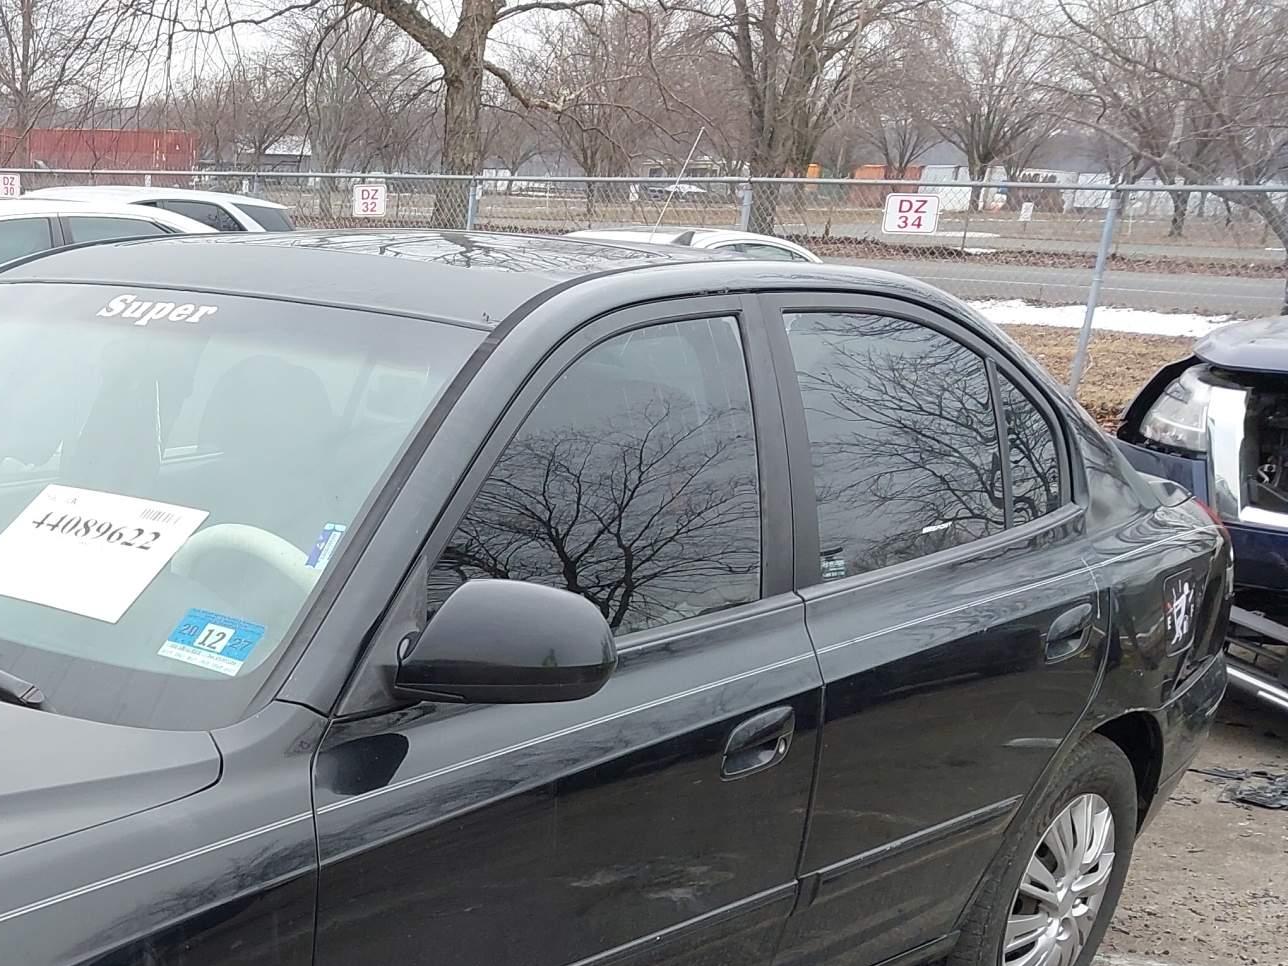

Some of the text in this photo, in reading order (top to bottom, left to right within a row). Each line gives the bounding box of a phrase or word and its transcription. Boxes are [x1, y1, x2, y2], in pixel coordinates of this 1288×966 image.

[3, 176, 16, 186] DZ
[3, 187, 15, 196] 30
[361, 189, 379, 200] DZ
[362, 201, 377, 212] 32
[898, 199, 928, 213] DZ
[897, 215, 923, 229] 34
[95, 294, 218, 326] Super
[32, 511, 161, 550] 44089622
[198, 628, 227, 650] 12
